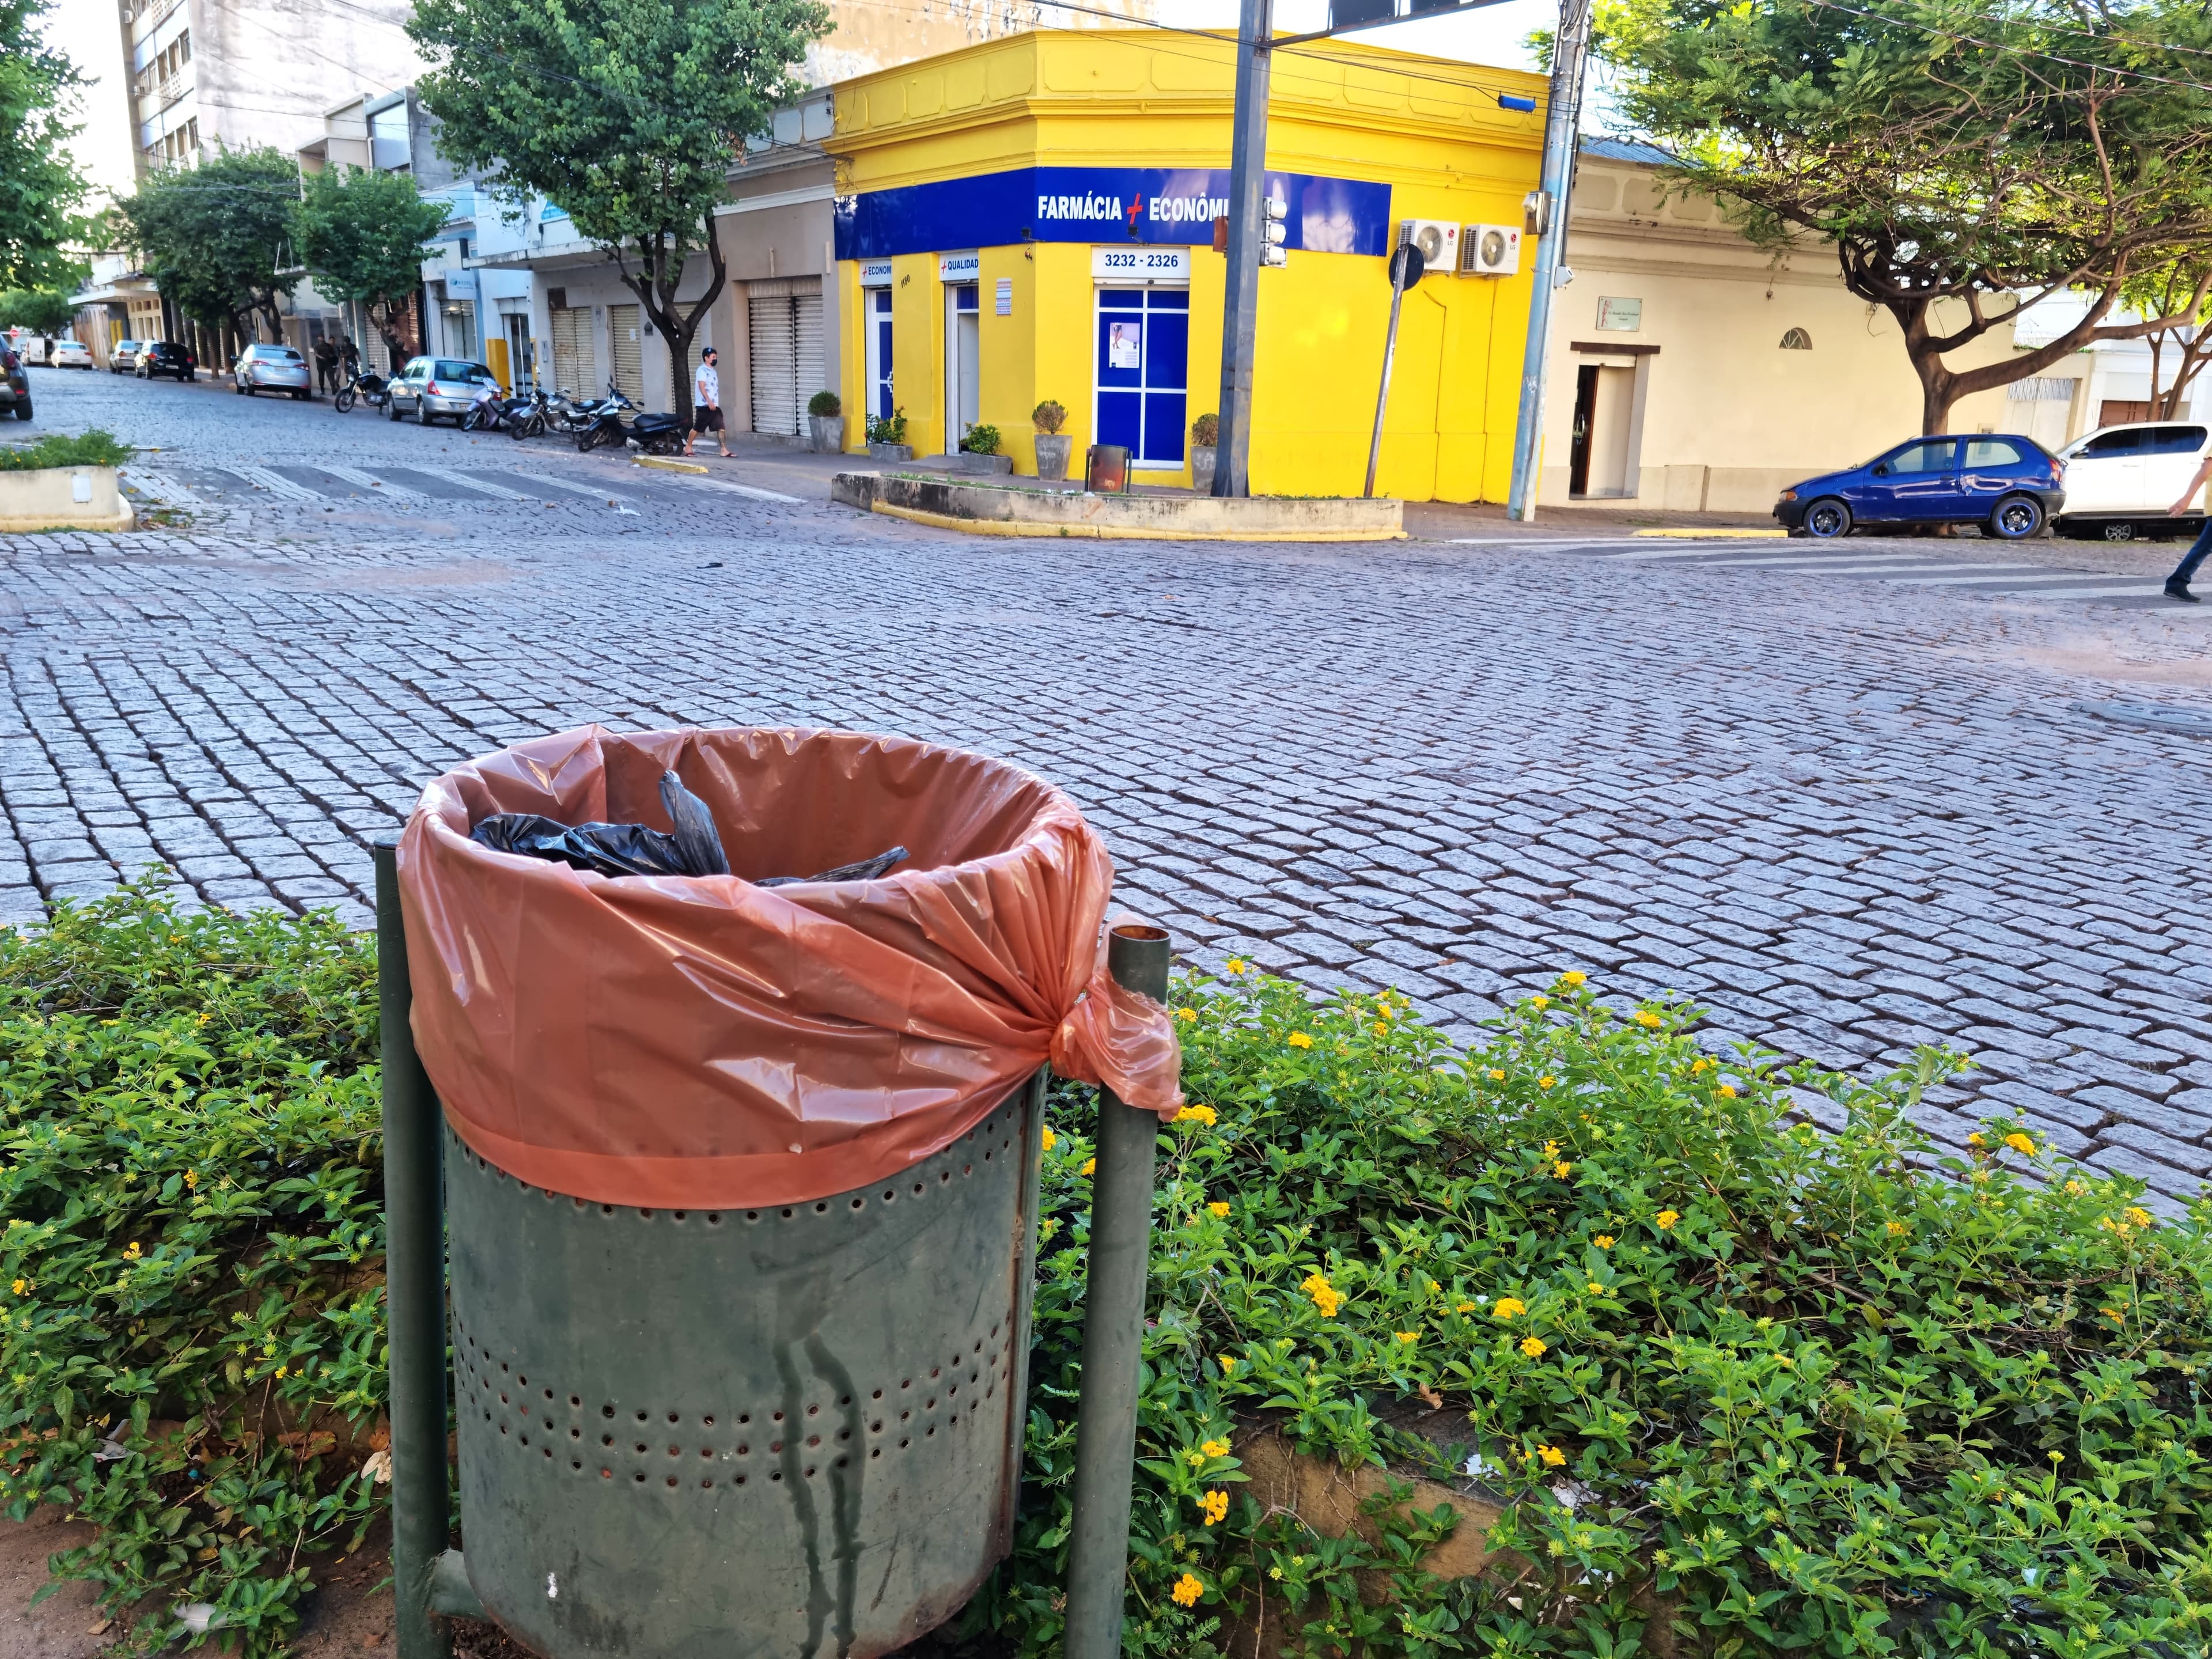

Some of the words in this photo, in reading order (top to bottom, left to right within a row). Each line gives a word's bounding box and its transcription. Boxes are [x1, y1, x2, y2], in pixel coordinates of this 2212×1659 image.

[1038, 191, 1122, 220] FARMÁCIA
[1149, 192, 1229, 222] ECONÔMI
[948, 259, 979, 271] QUALIDAD
[1105, 254, 1135, 266] 3232
[1147, 255, 1178, 267] 2326
[868, 265, 891, 275] ECONOM
[901, 274, 910, 288] 1180
